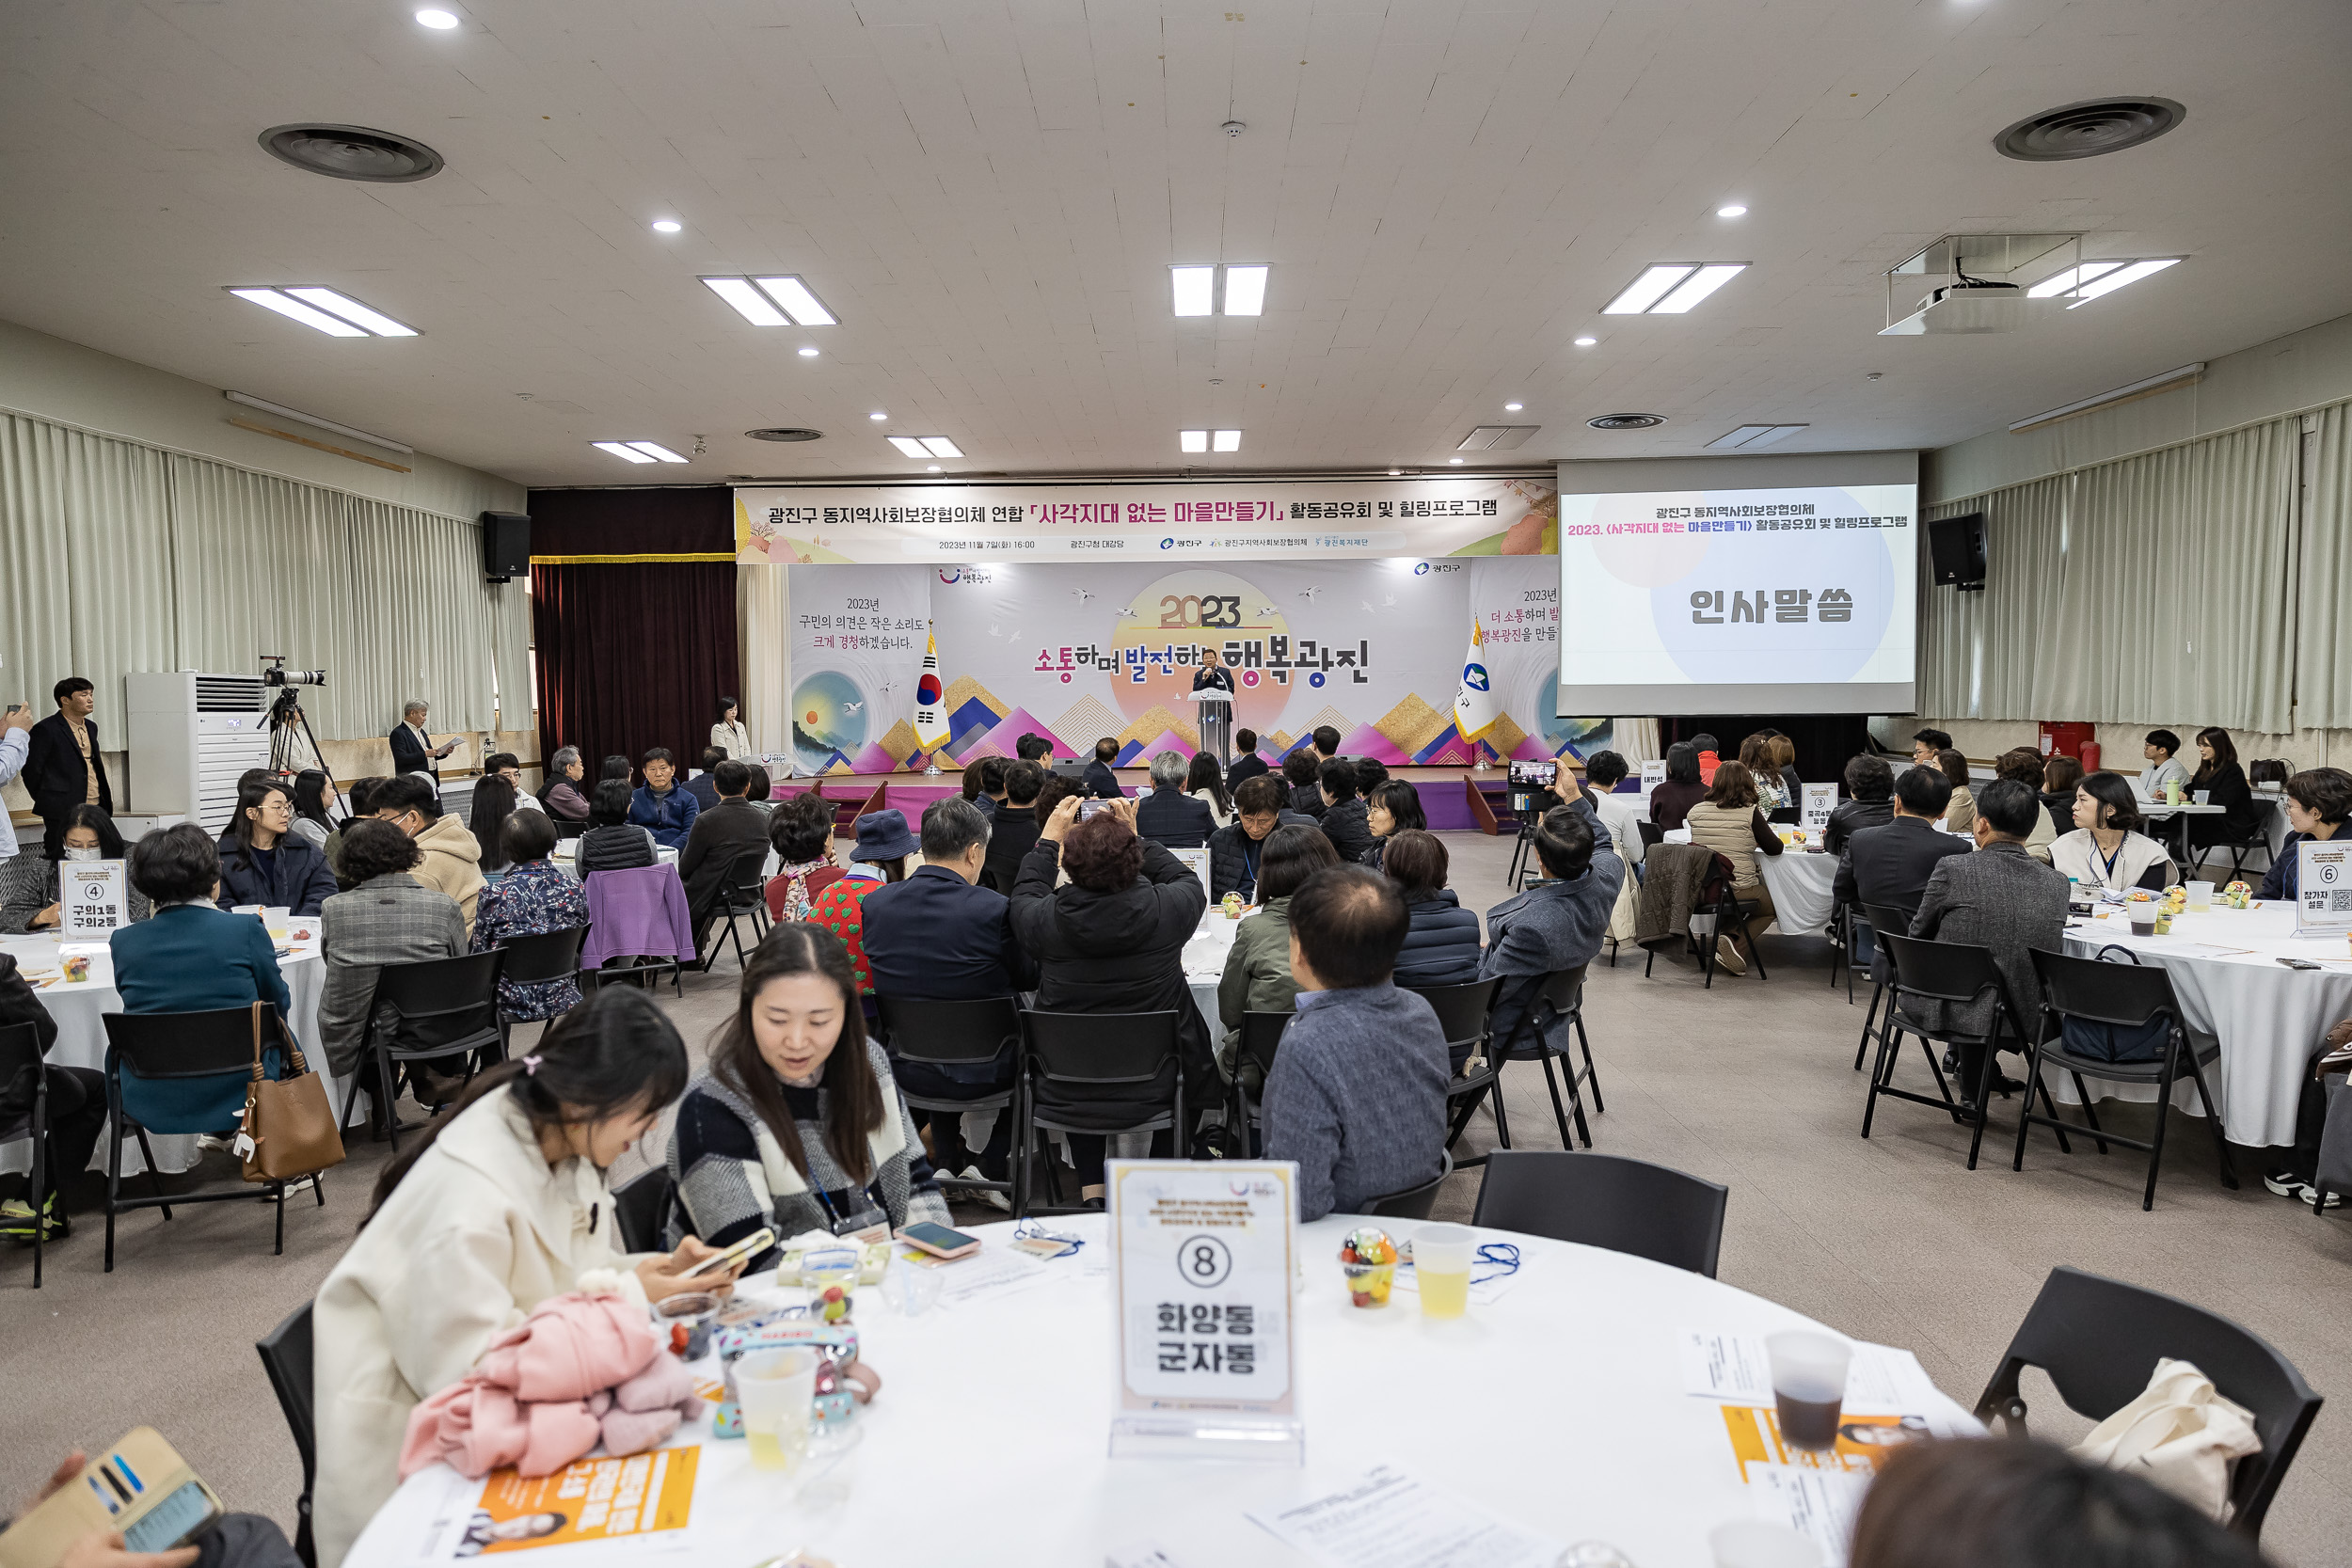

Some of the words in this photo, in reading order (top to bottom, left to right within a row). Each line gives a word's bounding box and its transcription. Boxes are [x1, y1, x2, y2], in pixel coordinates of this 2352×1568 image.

[769, 507, 818, 524] 광진구
[823, 505, 986, 524] 동지역사회보장협의체
[993, 506, 1024, 523] 연합
[1127, 502, 1167, 524] 없는
[1290, 500, 1371, 519] 활동공유회
[1378, 500, 1392, 518] 및
[1400, 499, 1497, 517] 힐링프로그램
[1656, 507, 1691, 519] 광진구
[1694, 503, 1815, 517] 동지역사회보장협의체
[1568, 524, 1603, 536] 2023.
[1662, 521, 1684, 534] 없는
[1756, 519, 1816, 531] 활동공유회
[1820, 518, 1830, 531] 및
[1835, 515, 1908, 529] 힐링프로그램
[939, 541, 966, 549] 2023년
[986, 541, 1011, 549] 7일(화)
[1071, 540, 1100, 548] 광진구청
[1103, 540, 1124, 548] 대강당
[1176, 539, 1202, 547] 광진구
[1225, 538, 1307, 547] 광진구지역사회보장협의체
[1524, 588, 1556, 602] 2023년
[848, 598, 879, 611] 2023년
[1159, 594, 1241, 628] 2023
[1690, 588, 1852, 624] 인사말씀
[800, 615, 832, 629] 구민의
[835, 616, 867, 630] 의견은
[870, 618, 891, 630] 작은
[895, 618, 924, 631] 소리도
[1491, 610, 1501, 624] 더
[1503, 608, 1546, 623] 소통하며
[814, 635, 834, 648] 크게
[838, 635, 913, 650] 경청하겠습니다.
[1482, 627, 1532, 644] 행복광진을
[1034, 643, 1120, 684] 소통하며
[1222, 635, 1368, 688] 행복광진
[2304, 891, 2328, 899] 참가자
[73, 905, 117, 915] 구의1동
[74, 917, 117, 927] 구의2동
[1194, 1245, 1216, 1277] 8
[1156, 1302, 1254, 1336] 화양동
[1158, 1342, 1255, 1374] 군자동
